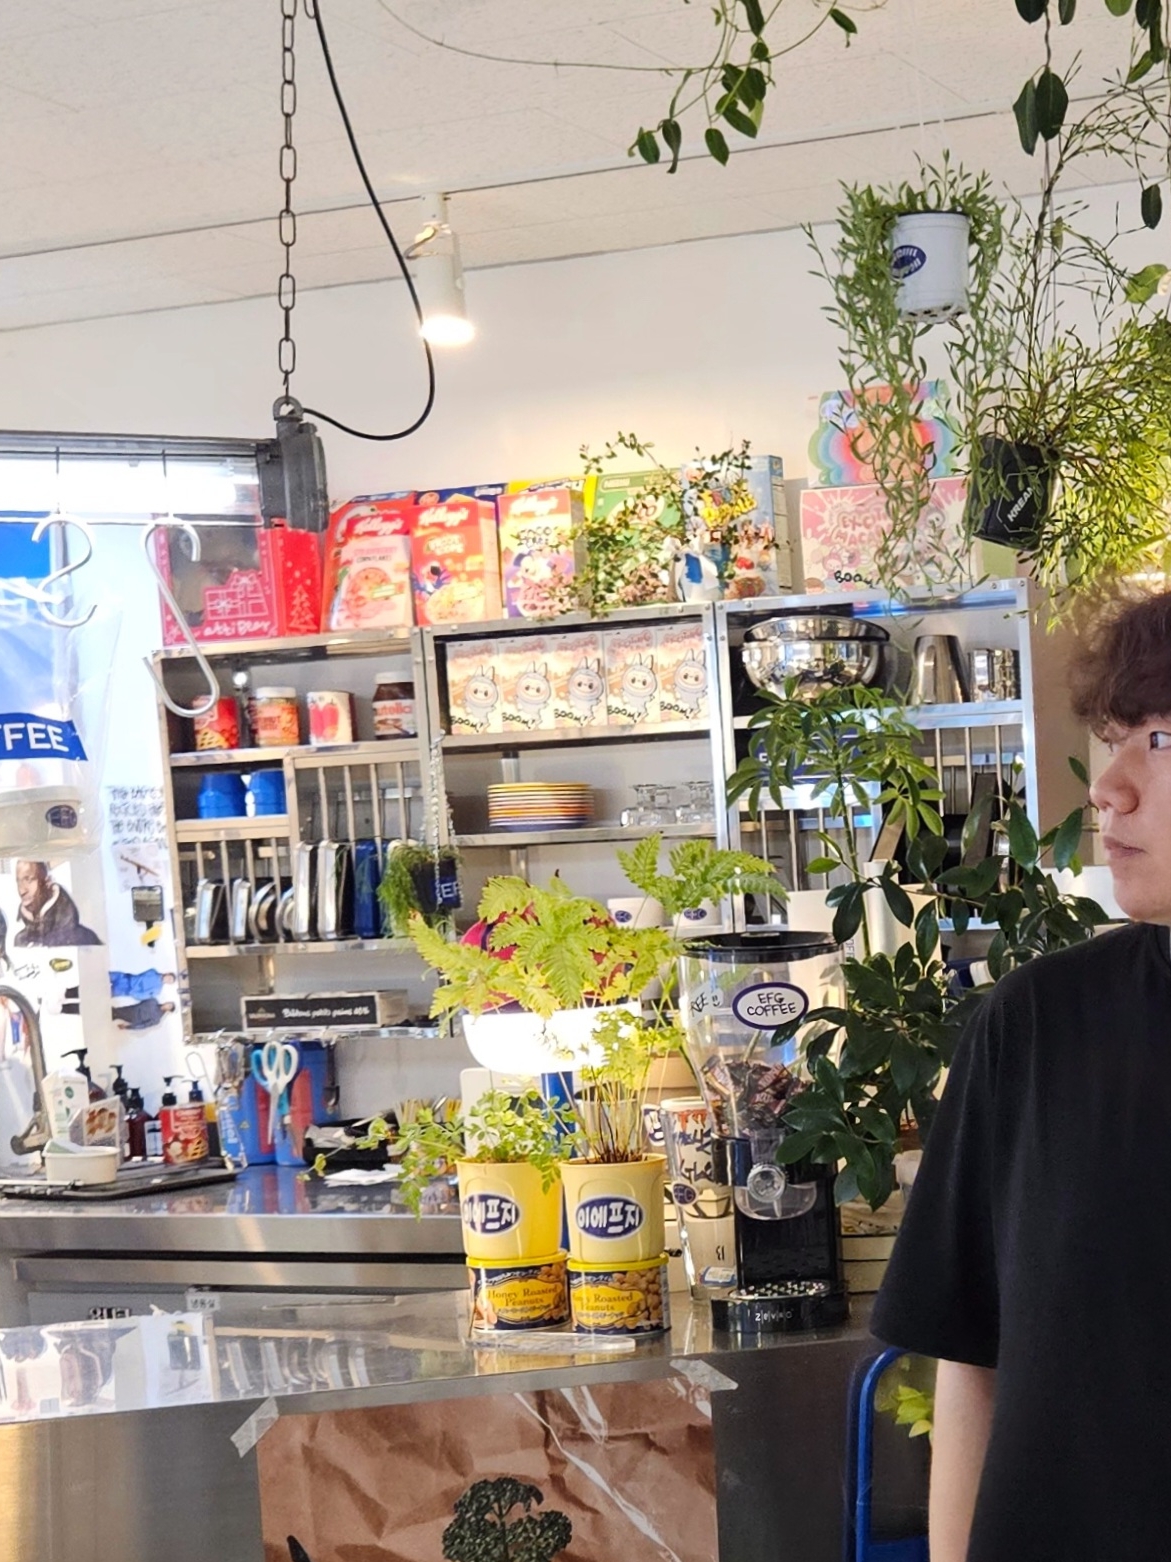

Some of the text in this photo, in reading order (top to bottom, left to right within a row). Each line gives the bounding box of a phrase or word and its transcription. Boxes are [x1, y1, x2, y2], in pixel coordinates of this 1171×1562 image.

[758, 992, 785, 1004] EFG
[746, 1002, 797, 1018] COFFEE
[578, 1201, 640, 1234] 이에프지
[523, 1285, 559, 1297] Roasted
[594, 1292, 633, 1303] Roasted
